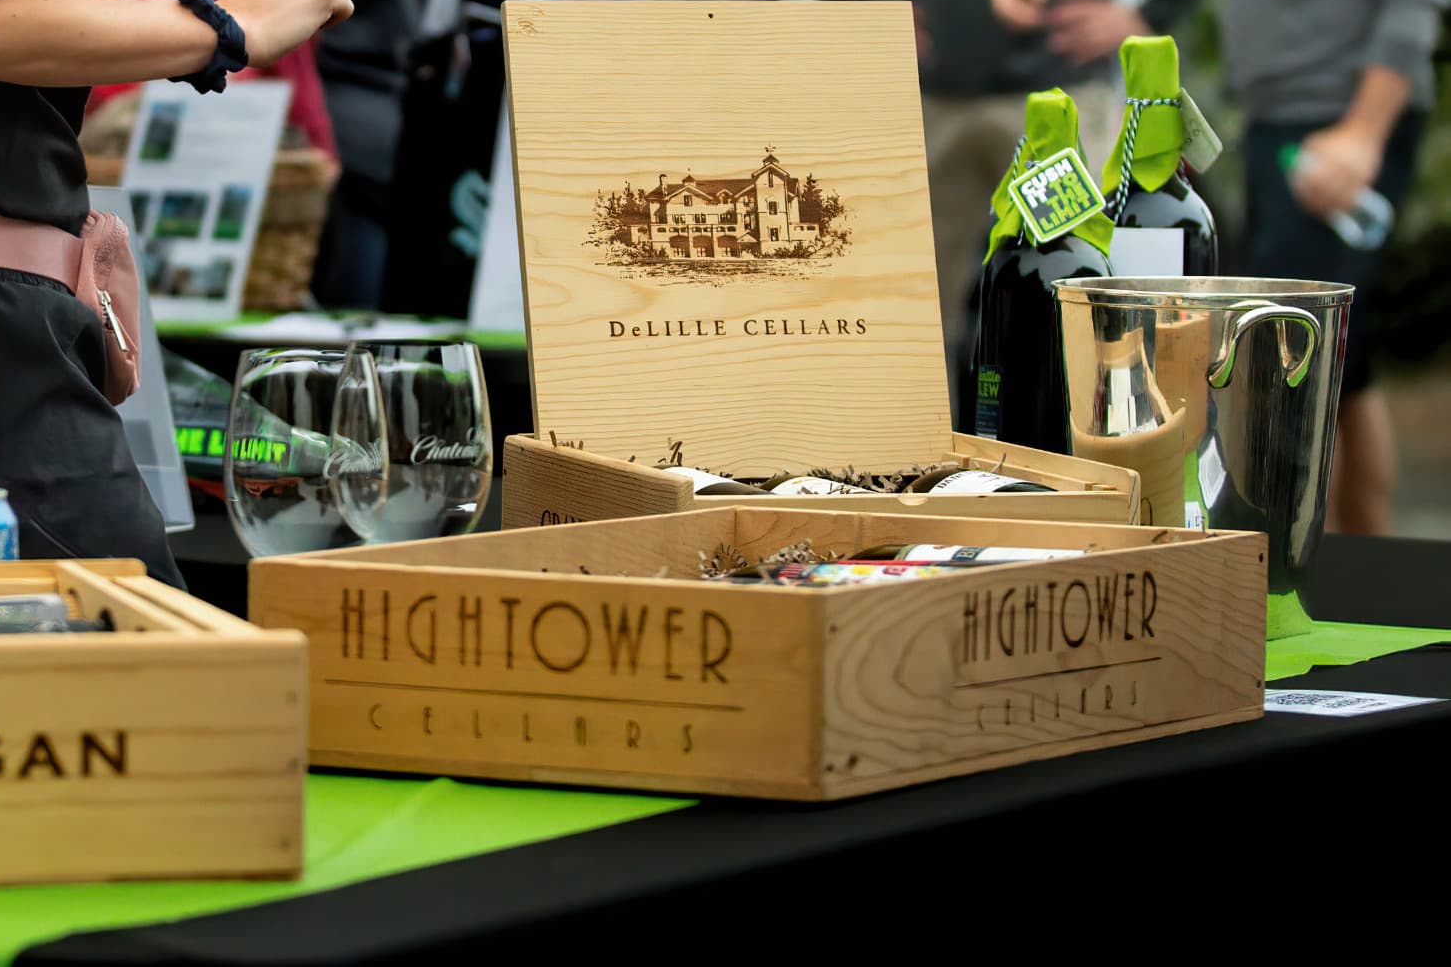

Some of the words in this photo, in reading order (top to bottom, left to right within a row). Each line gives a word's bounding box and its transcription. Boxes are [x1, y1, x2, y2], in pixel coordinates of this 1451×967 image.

[1025, 186, 1048, 209] IT
[1049, 172, 1079, 197] TO
[1038, 197, 1091, 231] LIMIT
[609, 320, 727, 338] DeLILLE
[744, 318, 868, 336] CELLARS
[340, 587, 733, 684] HIGHTOWER
[963, 571, 1157, 664] HIGHTOWER
